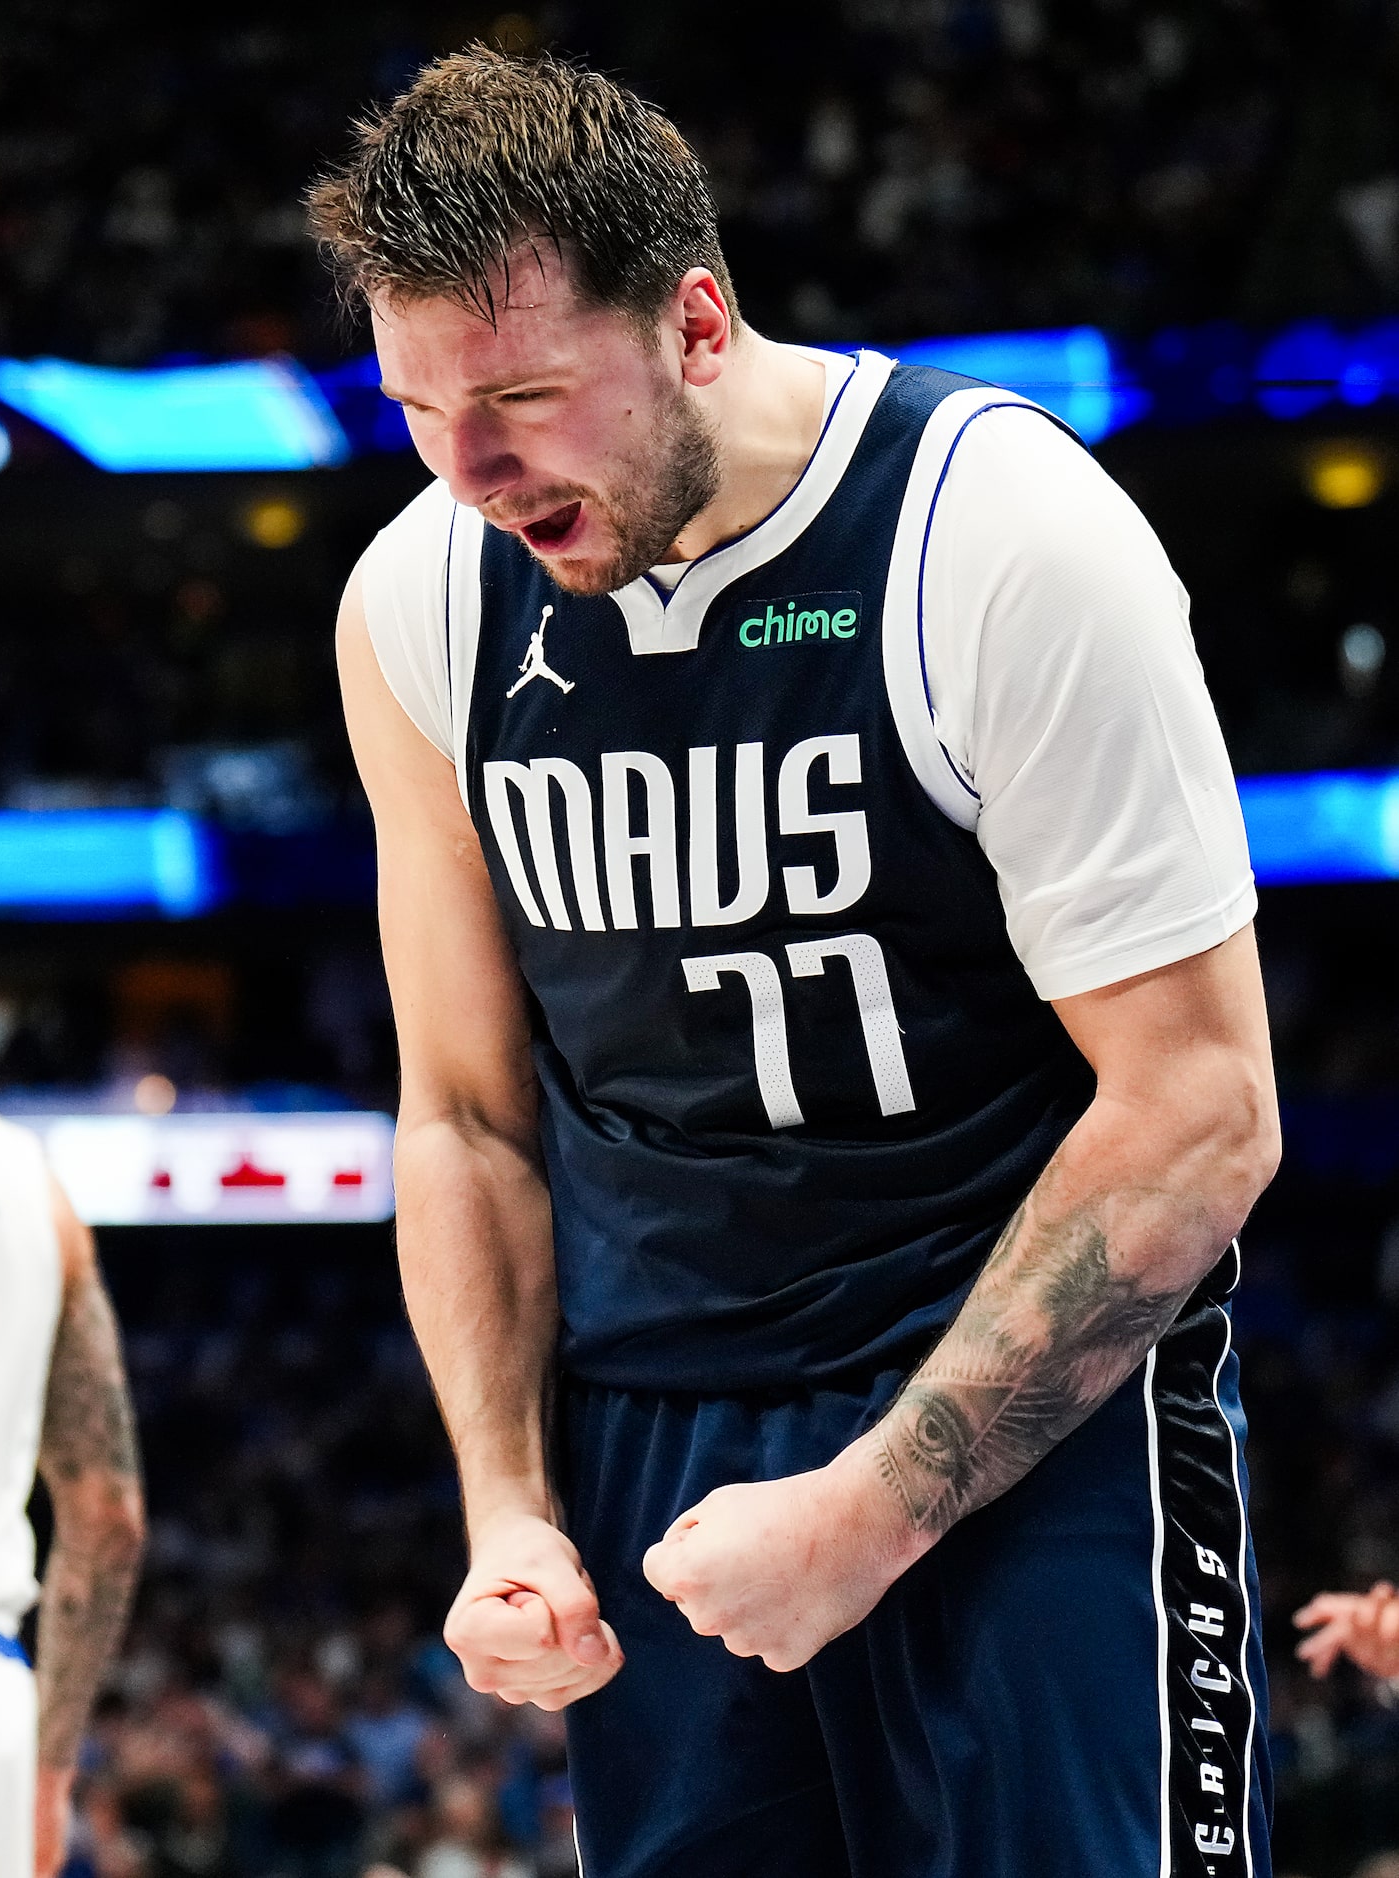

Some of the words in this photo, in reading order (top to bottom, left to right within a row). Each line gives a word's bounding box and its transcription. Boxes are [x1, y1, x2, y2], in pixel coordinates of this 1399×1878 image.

[739, 601, 857, 649] chime
[483, 733, 872, 931] MAVS
[681, 933, 916, 1130] 77
